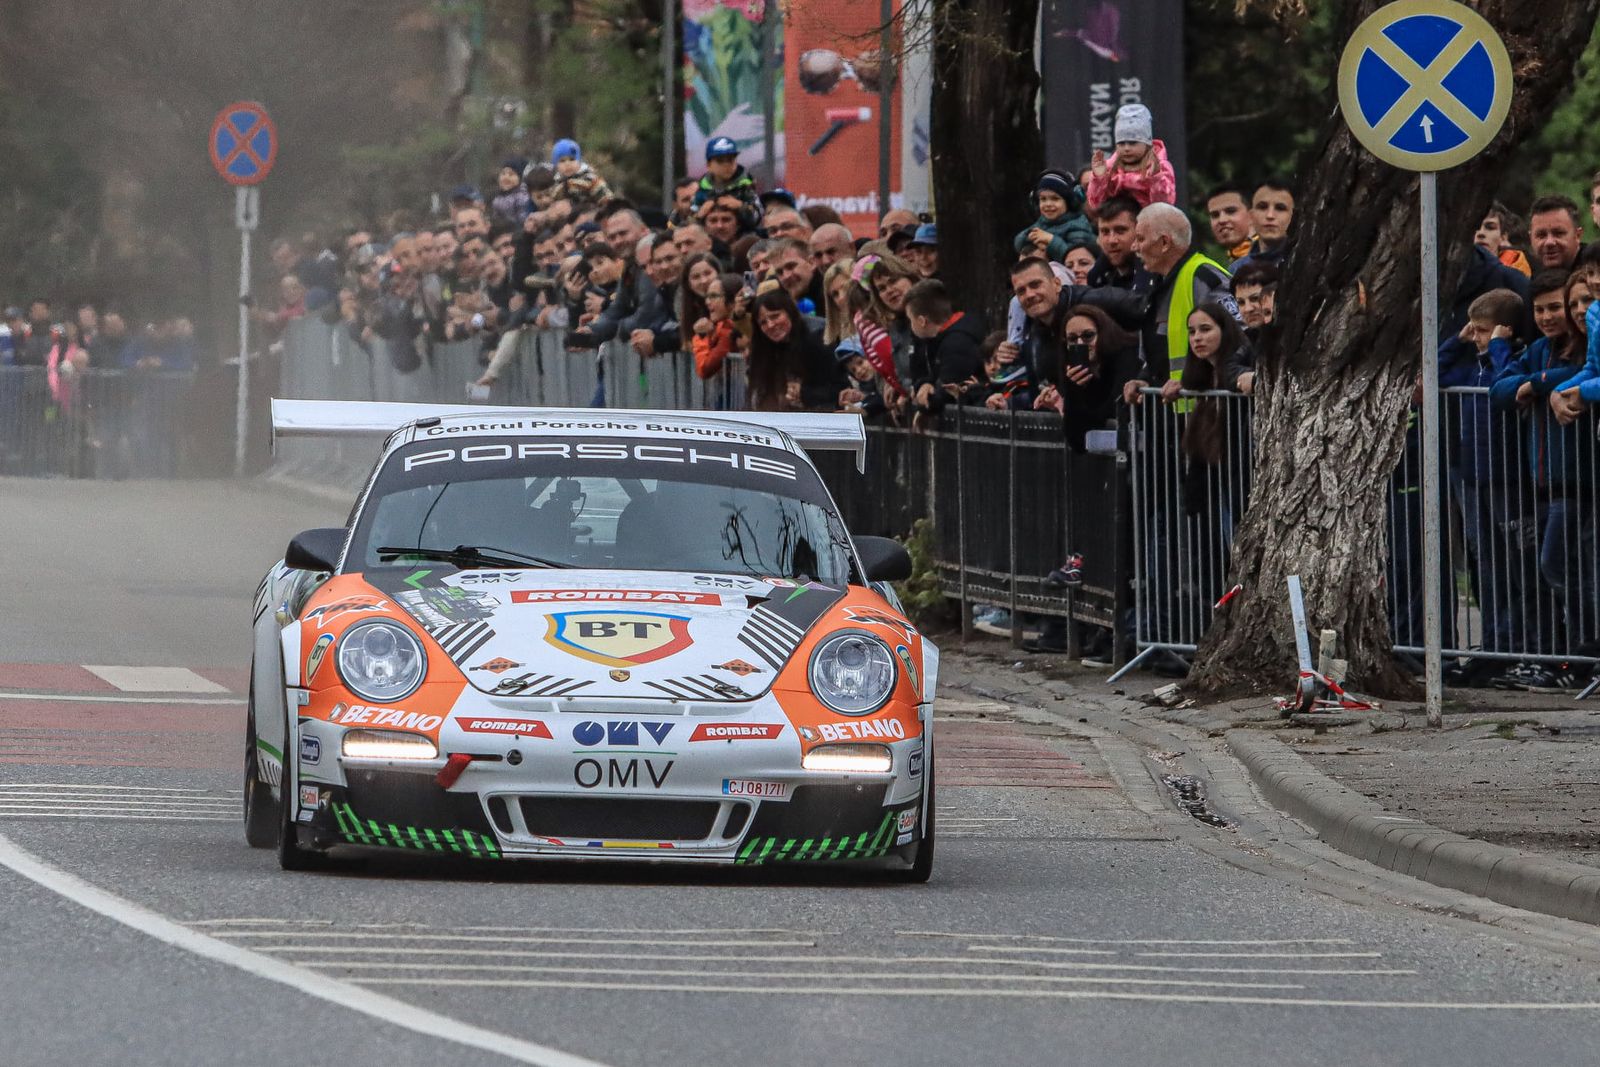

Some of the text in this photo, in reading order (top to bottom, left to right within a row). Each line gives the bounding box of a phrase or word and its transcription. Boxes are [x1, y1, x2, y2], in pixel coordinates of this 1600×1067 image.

[426, 421, 772, 446] Centrul Porsche București
[403, 443, 797, 481] PORSCHE
[527, 590, 705, 603] ROMBAT
[575, 621, 662, 639] BT
[341, 705, 443, 731] BETANO
[470, 720, 538, 732] ROMBAT
[706, 726, 768, 737] ROMBAT
[818, 718, 905, 742] BETANO
[573, 758, 675, 788] OMV
[729, 780, 786, 796] CJ 081711
